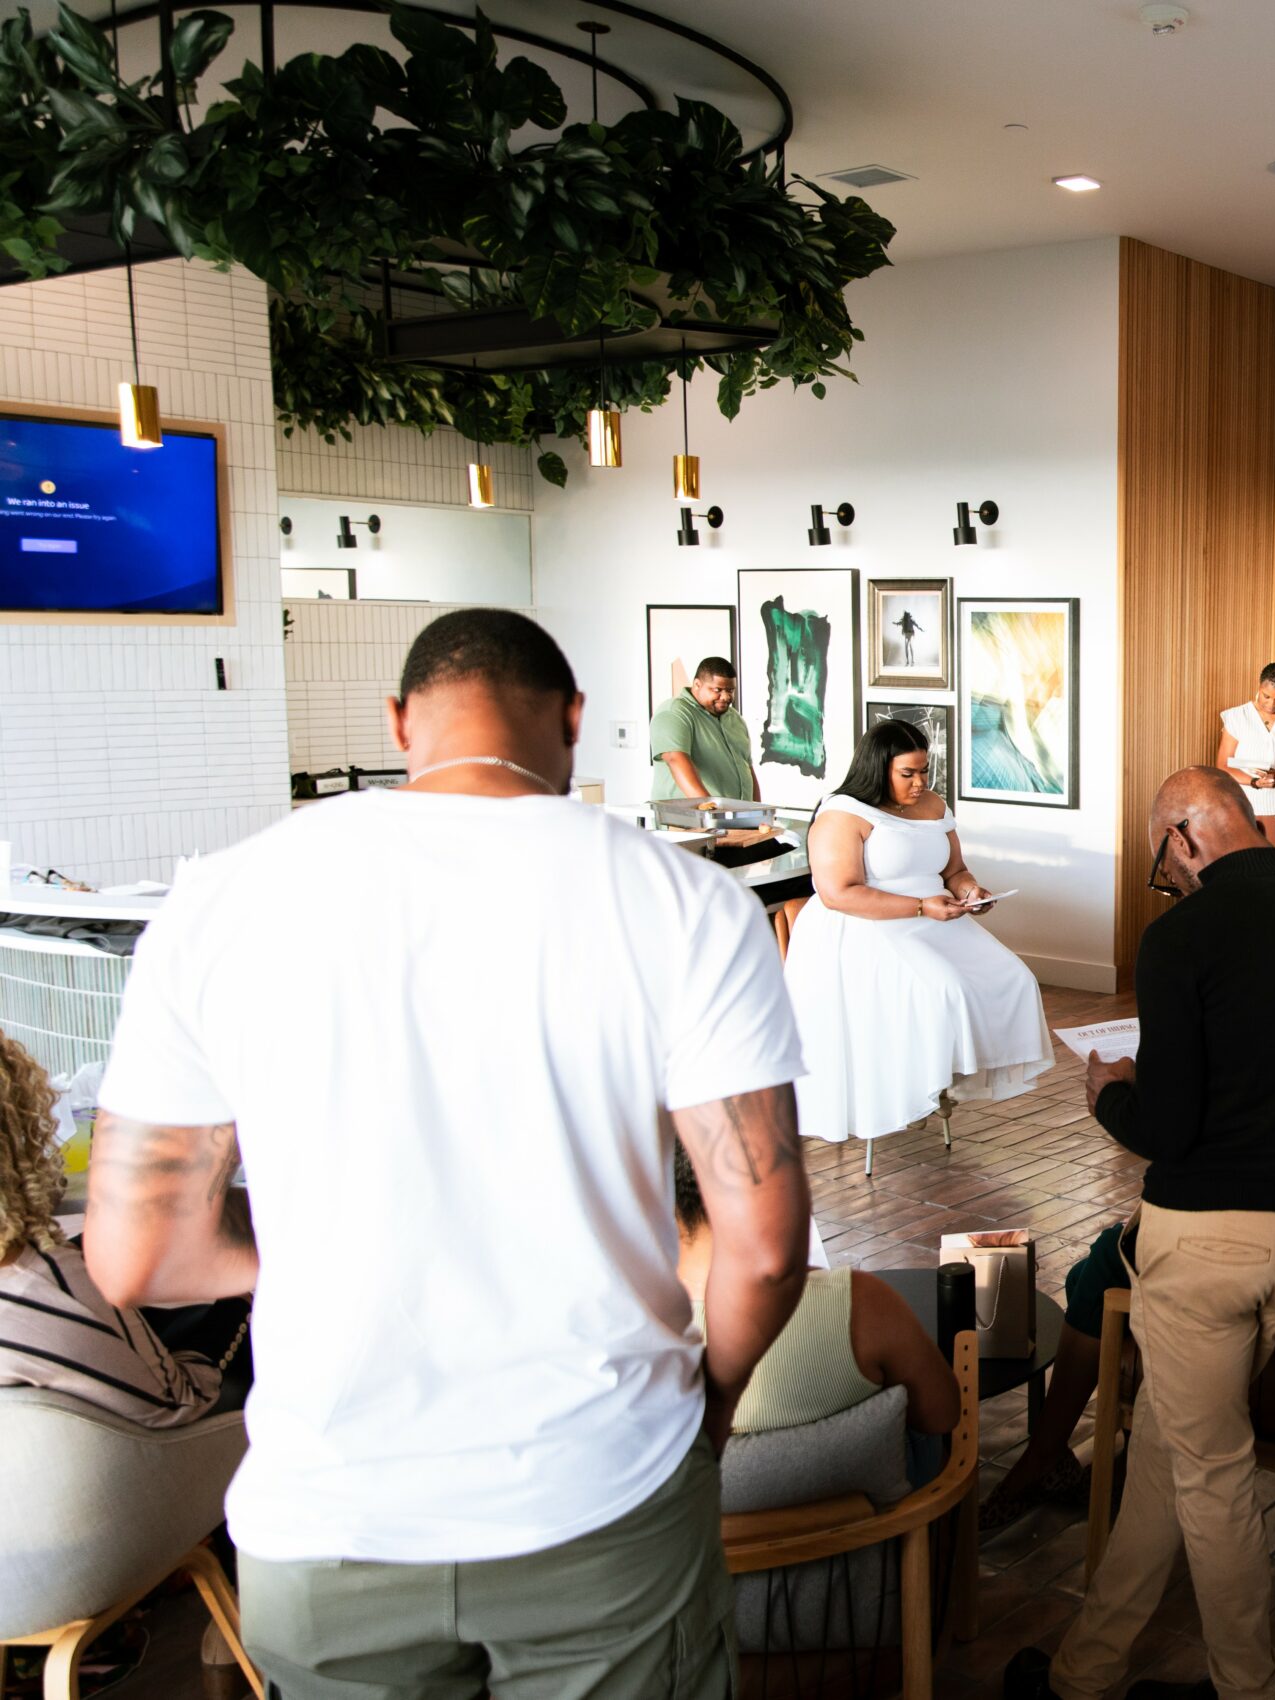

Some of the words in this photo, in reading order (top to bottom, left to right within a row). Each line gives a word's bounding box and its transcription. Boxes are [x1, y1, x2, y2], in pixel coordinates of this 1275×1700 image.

[7, 497, 21, 506] We
[22, 499, 37, 507] ran
[38, 499, 55, 508] into
[69, 501, 90, 510] issue
